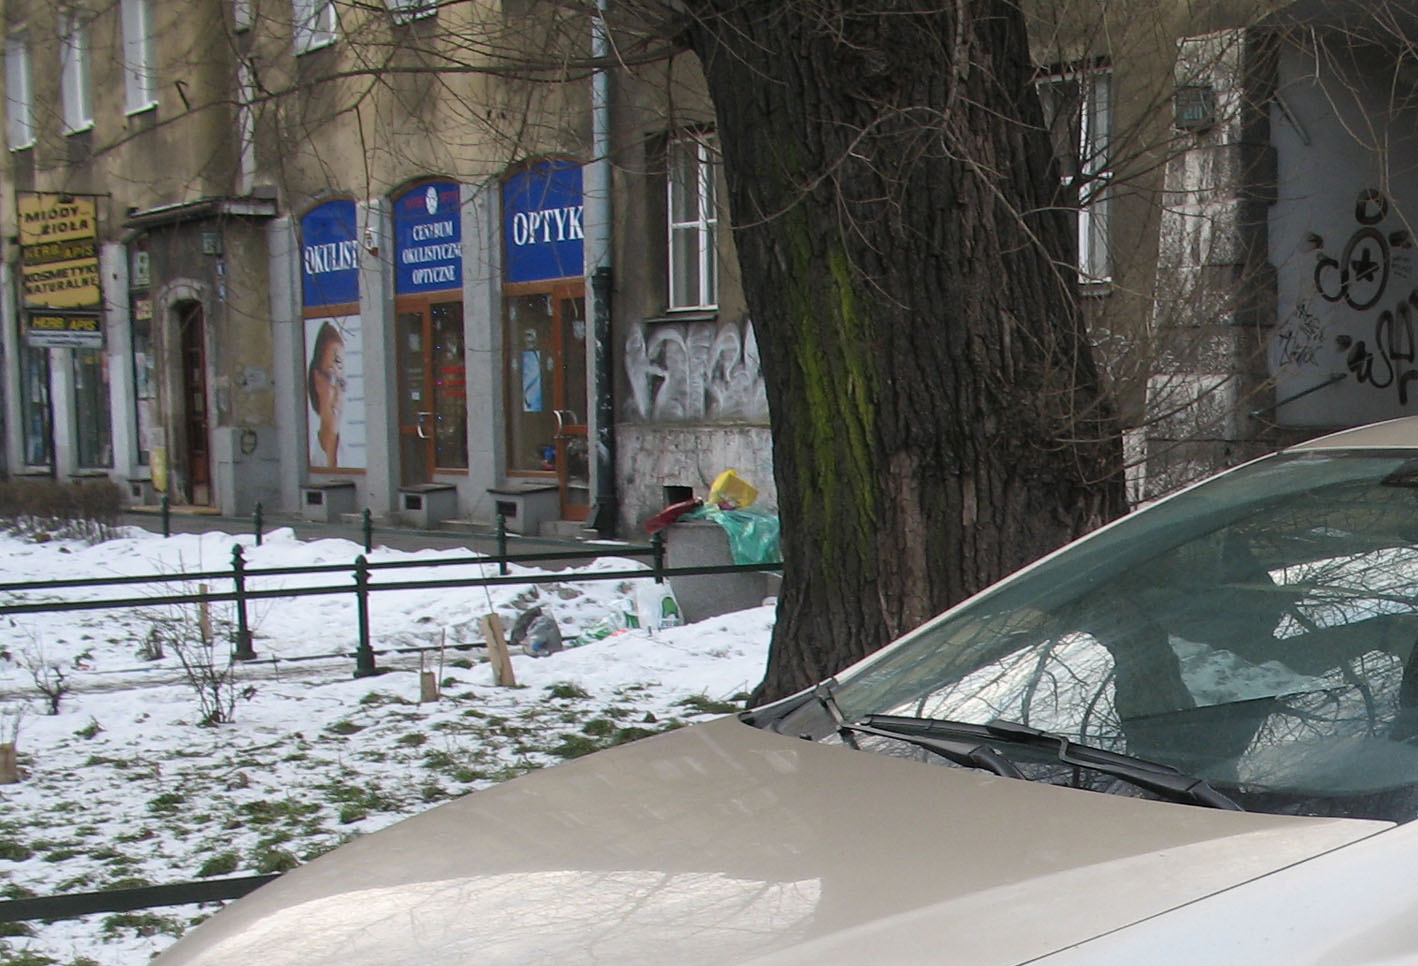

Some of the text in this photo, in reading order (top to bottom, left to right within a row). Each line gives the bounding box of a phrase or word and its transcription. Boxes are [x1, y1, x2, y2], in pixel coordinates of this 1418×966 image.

[412, 220, 453, 241] CENTRUM
[513, 205, 585, 246] OPTYK
[412, 265, 456, 285] OPTYCZNE
